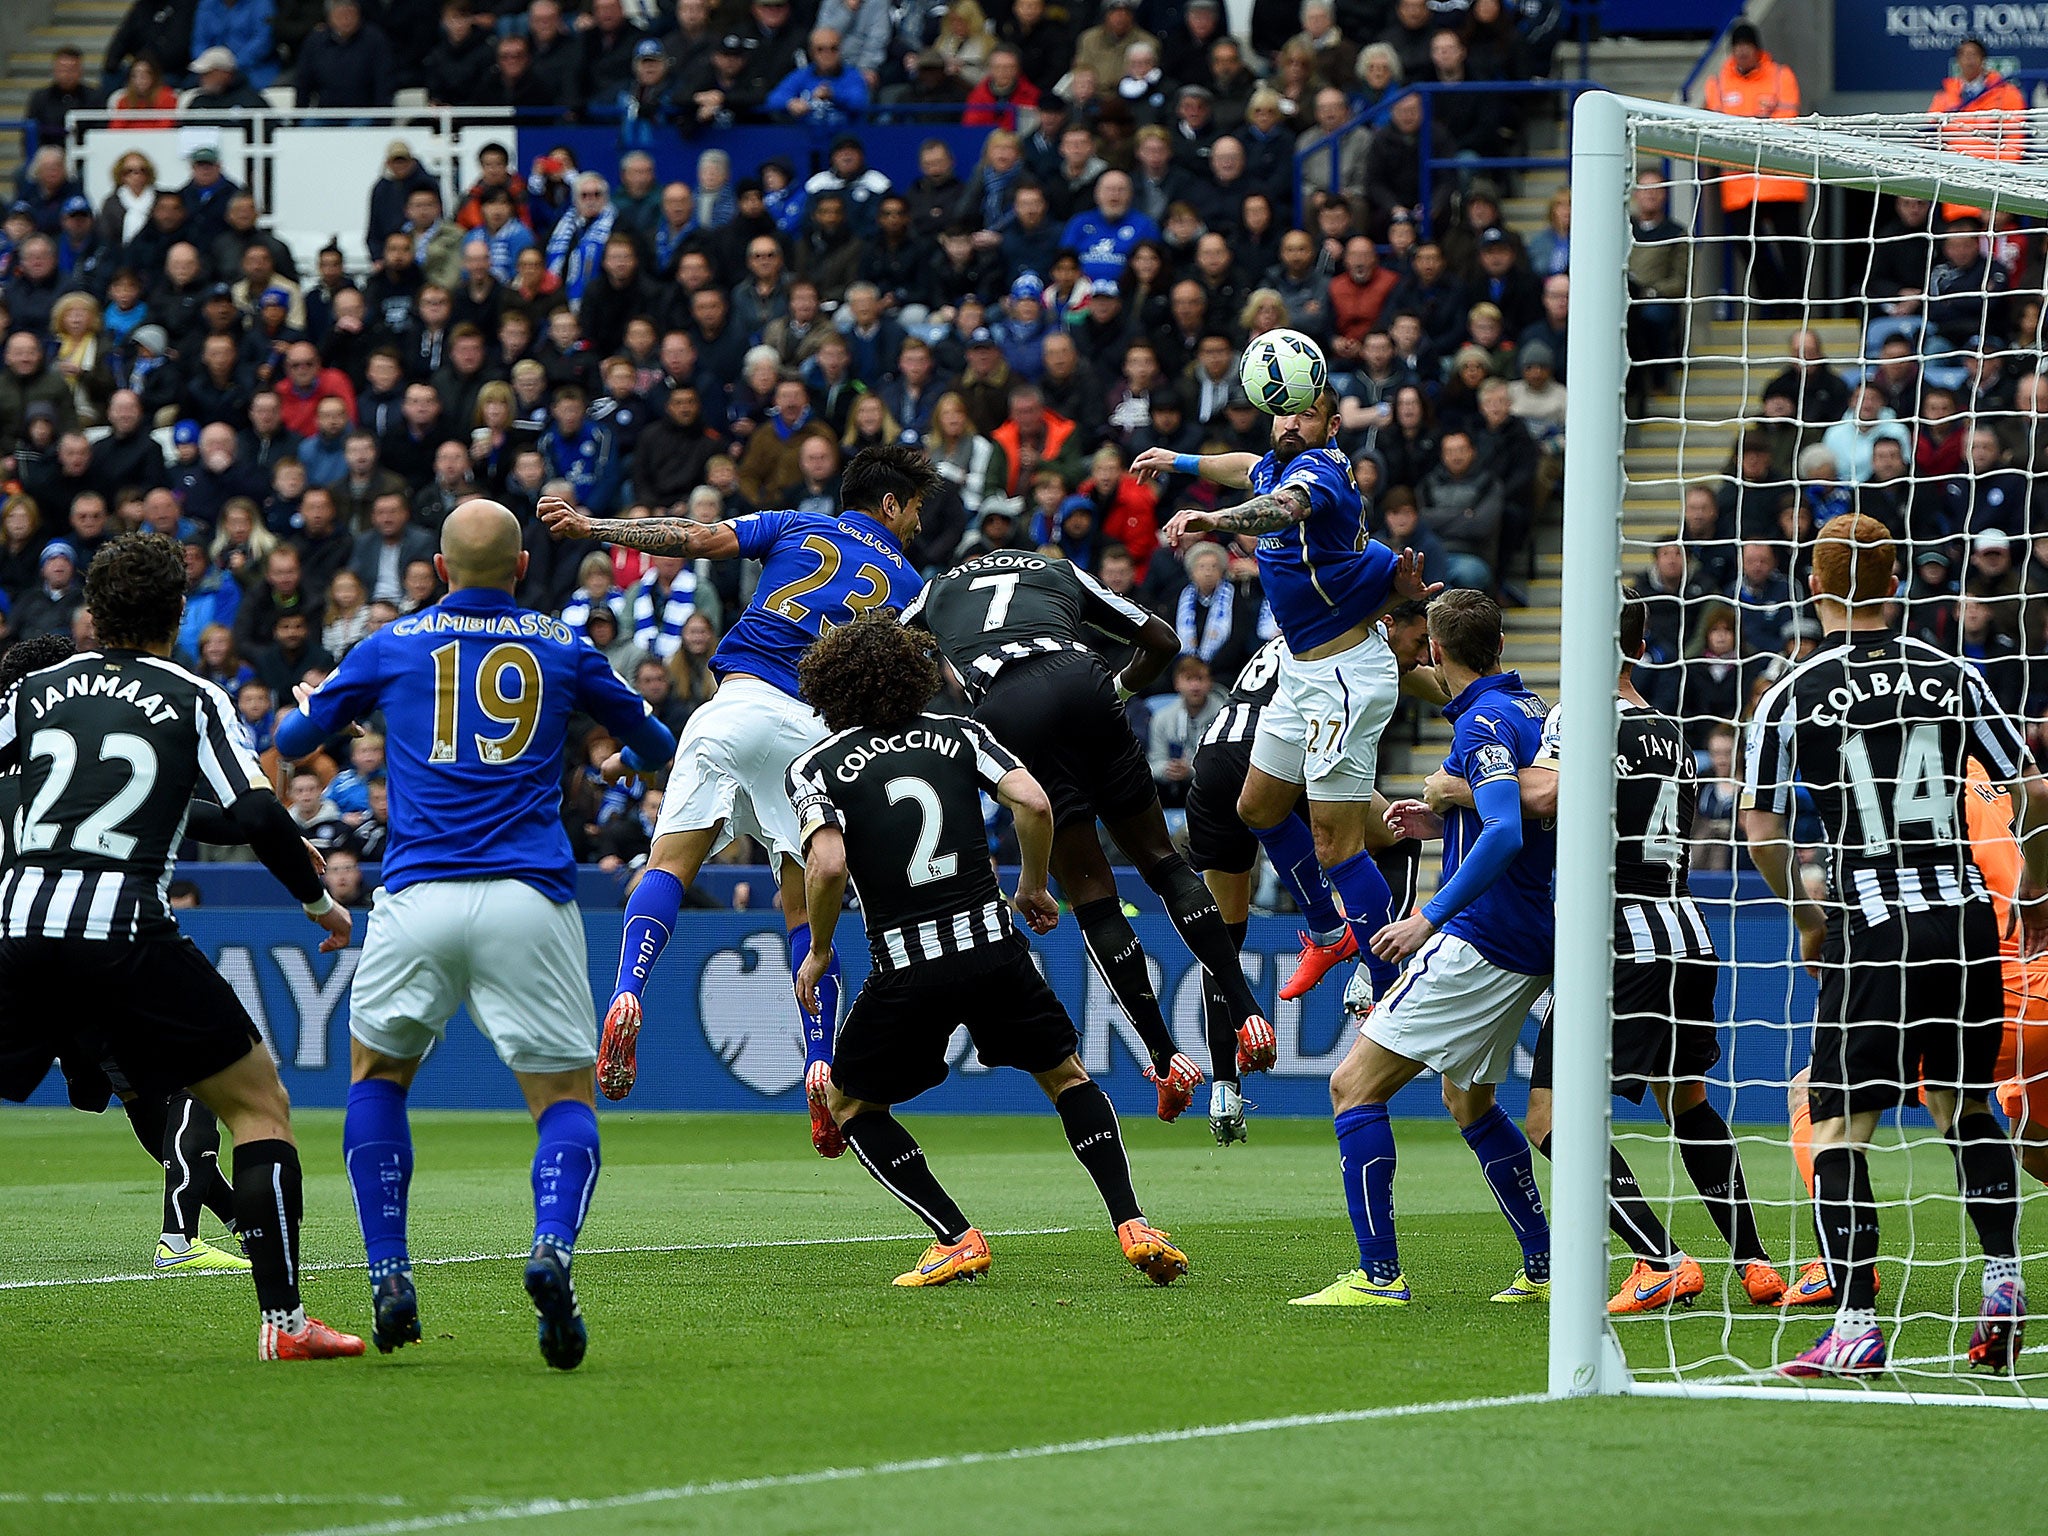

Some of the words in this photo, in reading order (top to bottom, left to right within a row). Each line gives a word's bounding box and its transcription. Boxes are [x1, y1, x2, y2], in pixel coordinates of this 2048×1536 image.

[1887, 5, 1968, 36] KING
[1973, 3, 2048, 34] POW
[838, 521, 903, 569] ULLOA
[938, 556, 1047, 579] SISSOKO
[762, 534, 891, 638] 23
[967, 572, 1020, 633] 7
[392, 612, 573, 646] CAMBIASSO
[30, 674, 180, 724] JANMAAT
[428, 639, 544, 765] 19
[1811, 672, 1961, 727] COLBACK
[836, 730, 961, 783] COLOCCINI
[1307, 719, 1342, 753] 27
[21, 728, 159, 860] 22
[1837, 723, 1956, 858] 14
[884, 776, 958, 887] 2
[1642, 779, 1684, 883] 4
[1182, 904, 1219, 924] NUFC
[1114, 936, 1141, 963] NUFC
[892, 1147, 924, 1167] NUFC
[1076, 1131, 1112, 1151] NUFC
